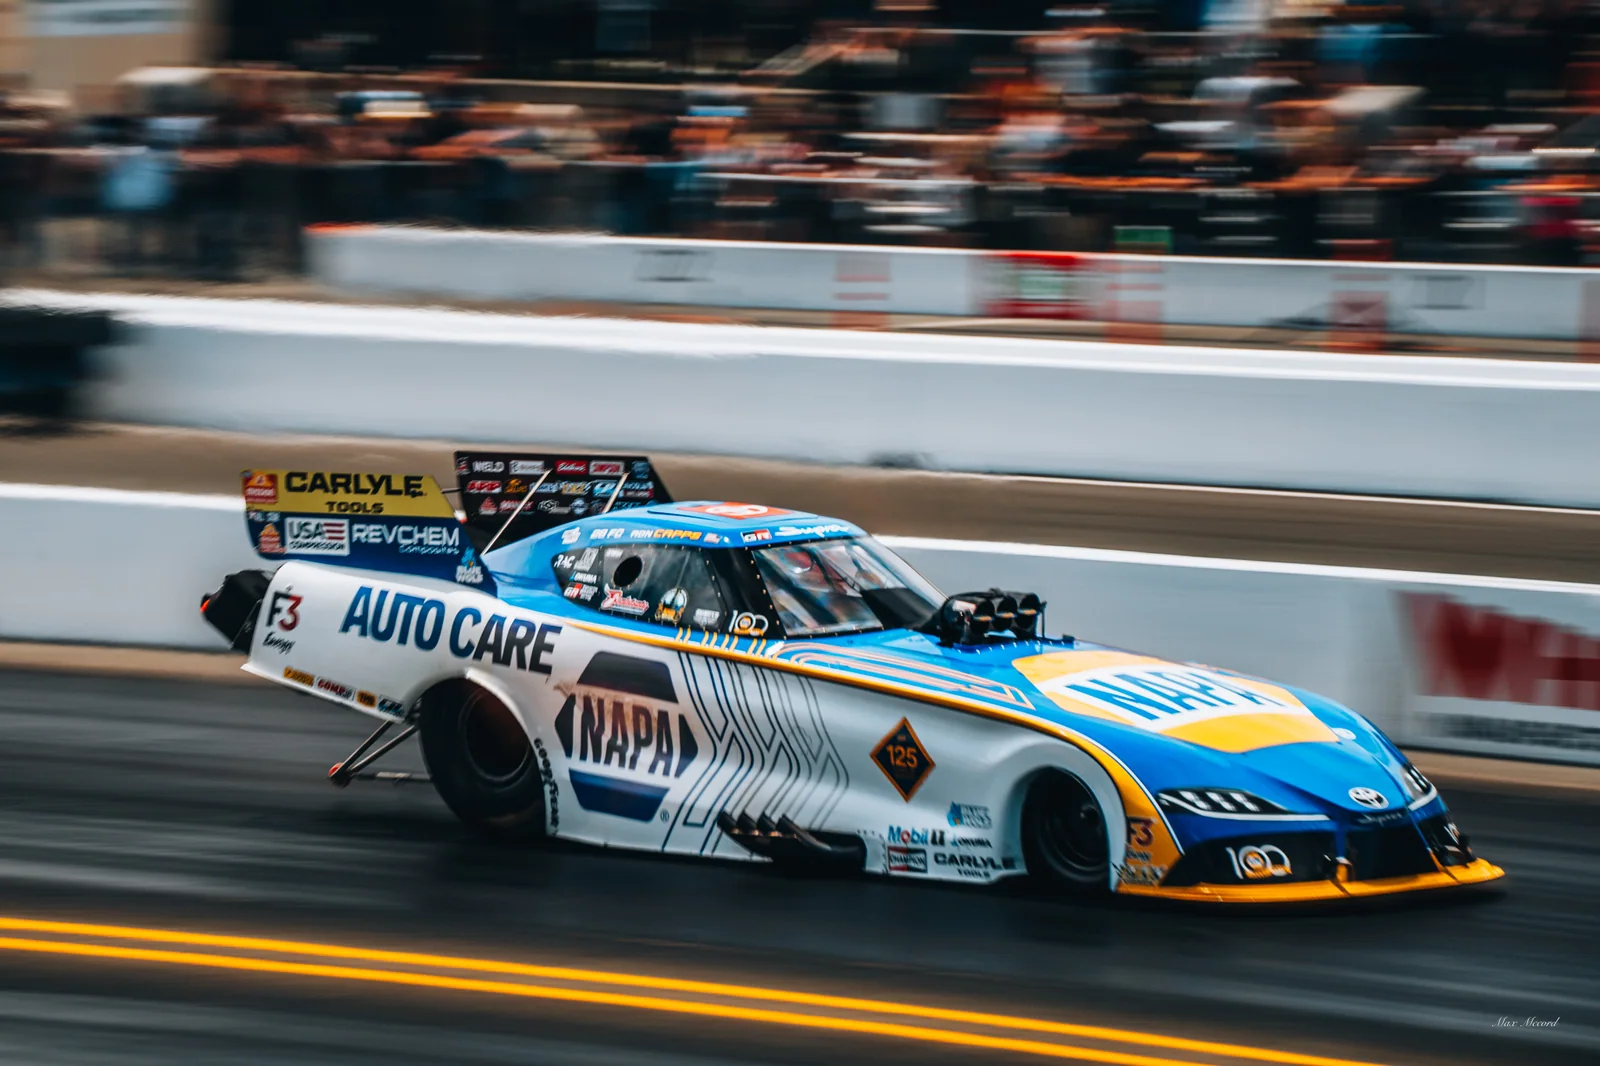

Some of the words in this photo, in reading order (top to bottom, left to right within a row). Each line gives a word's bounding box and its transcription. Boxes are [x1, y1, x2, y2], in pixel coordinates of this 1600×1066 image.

[472, 461, 505, 473] WELD
[284, 471, 423, 497] CARLYLE
[325, 501, 383, 514] TOOLS
[289, 520, 324, 540] USA
[351, 523, 459, 546] REVCHEM
[653, 528, 703, 541] CAPPS
[266, 590, 304, 632] F3
[339, 586, 446, 651] AUTO
[449, 607, 563, 676] CARE
[1064, 671, 1288, 721] NAPA
[579, 693, 671, 778] NAPA
[886, 744, 918, 769] 125
[887, 825, 929, 846] Mobil
[933, 852, 1017, 870] CARLYLE
